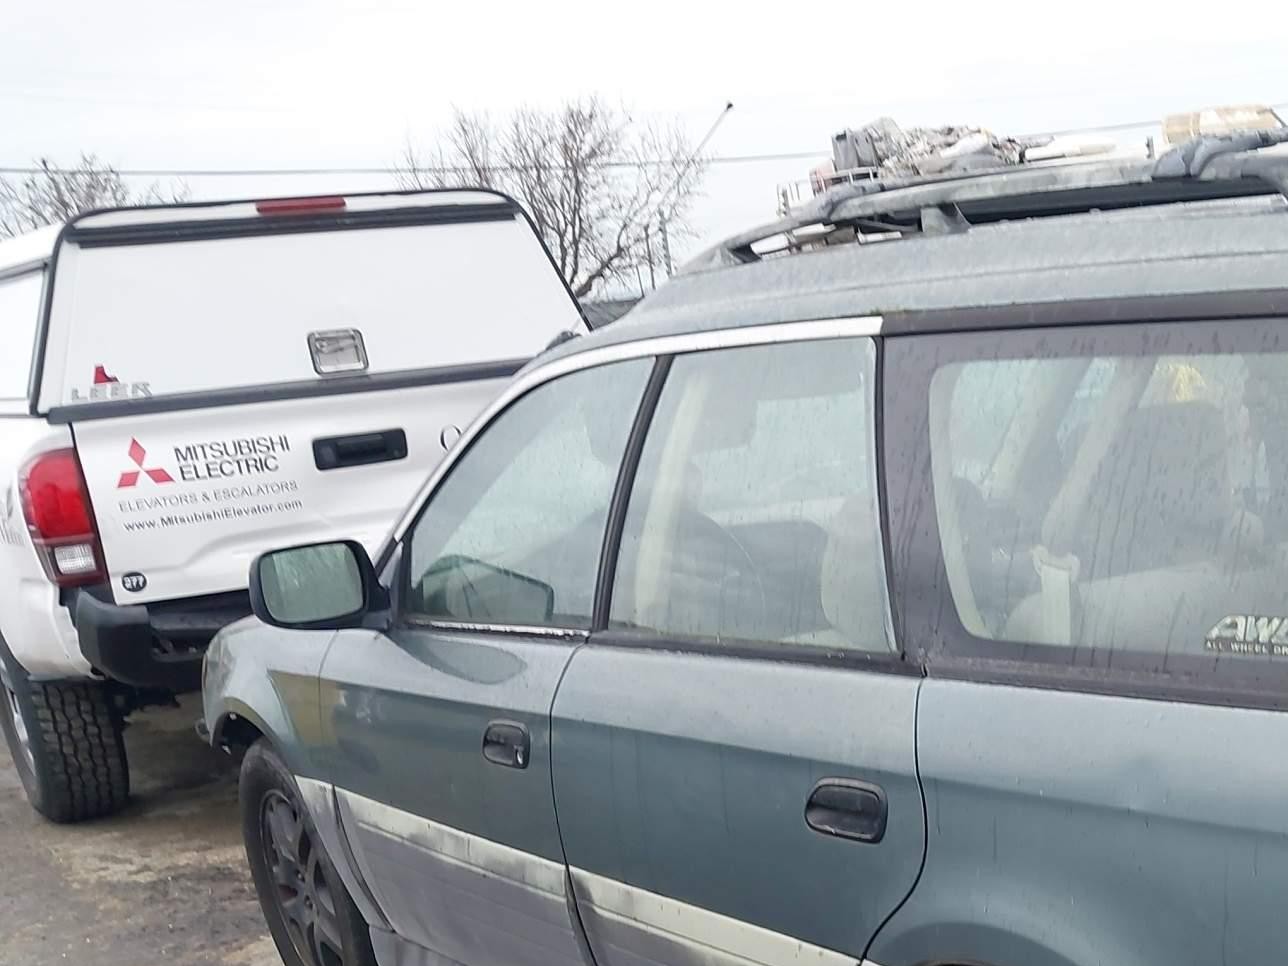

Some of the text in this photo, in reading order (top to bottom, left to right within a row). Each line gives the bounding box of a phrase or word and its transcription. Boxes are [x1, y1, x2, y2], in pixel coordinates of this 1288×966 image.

[72, 381, 153, 402] LEER
[174, 434, 291, 464] MITSUBISHI
[179, 456, 280, 481] ELECTRIC
[119, 480, 299, 512] ELEVATORS & ESCALATORS
[124, 500, 303, 532] www.MitsubishiElevator.com
[1205, 640, 1223, 650] ALL
[1230, 641, 1269, 654] WHEEL
